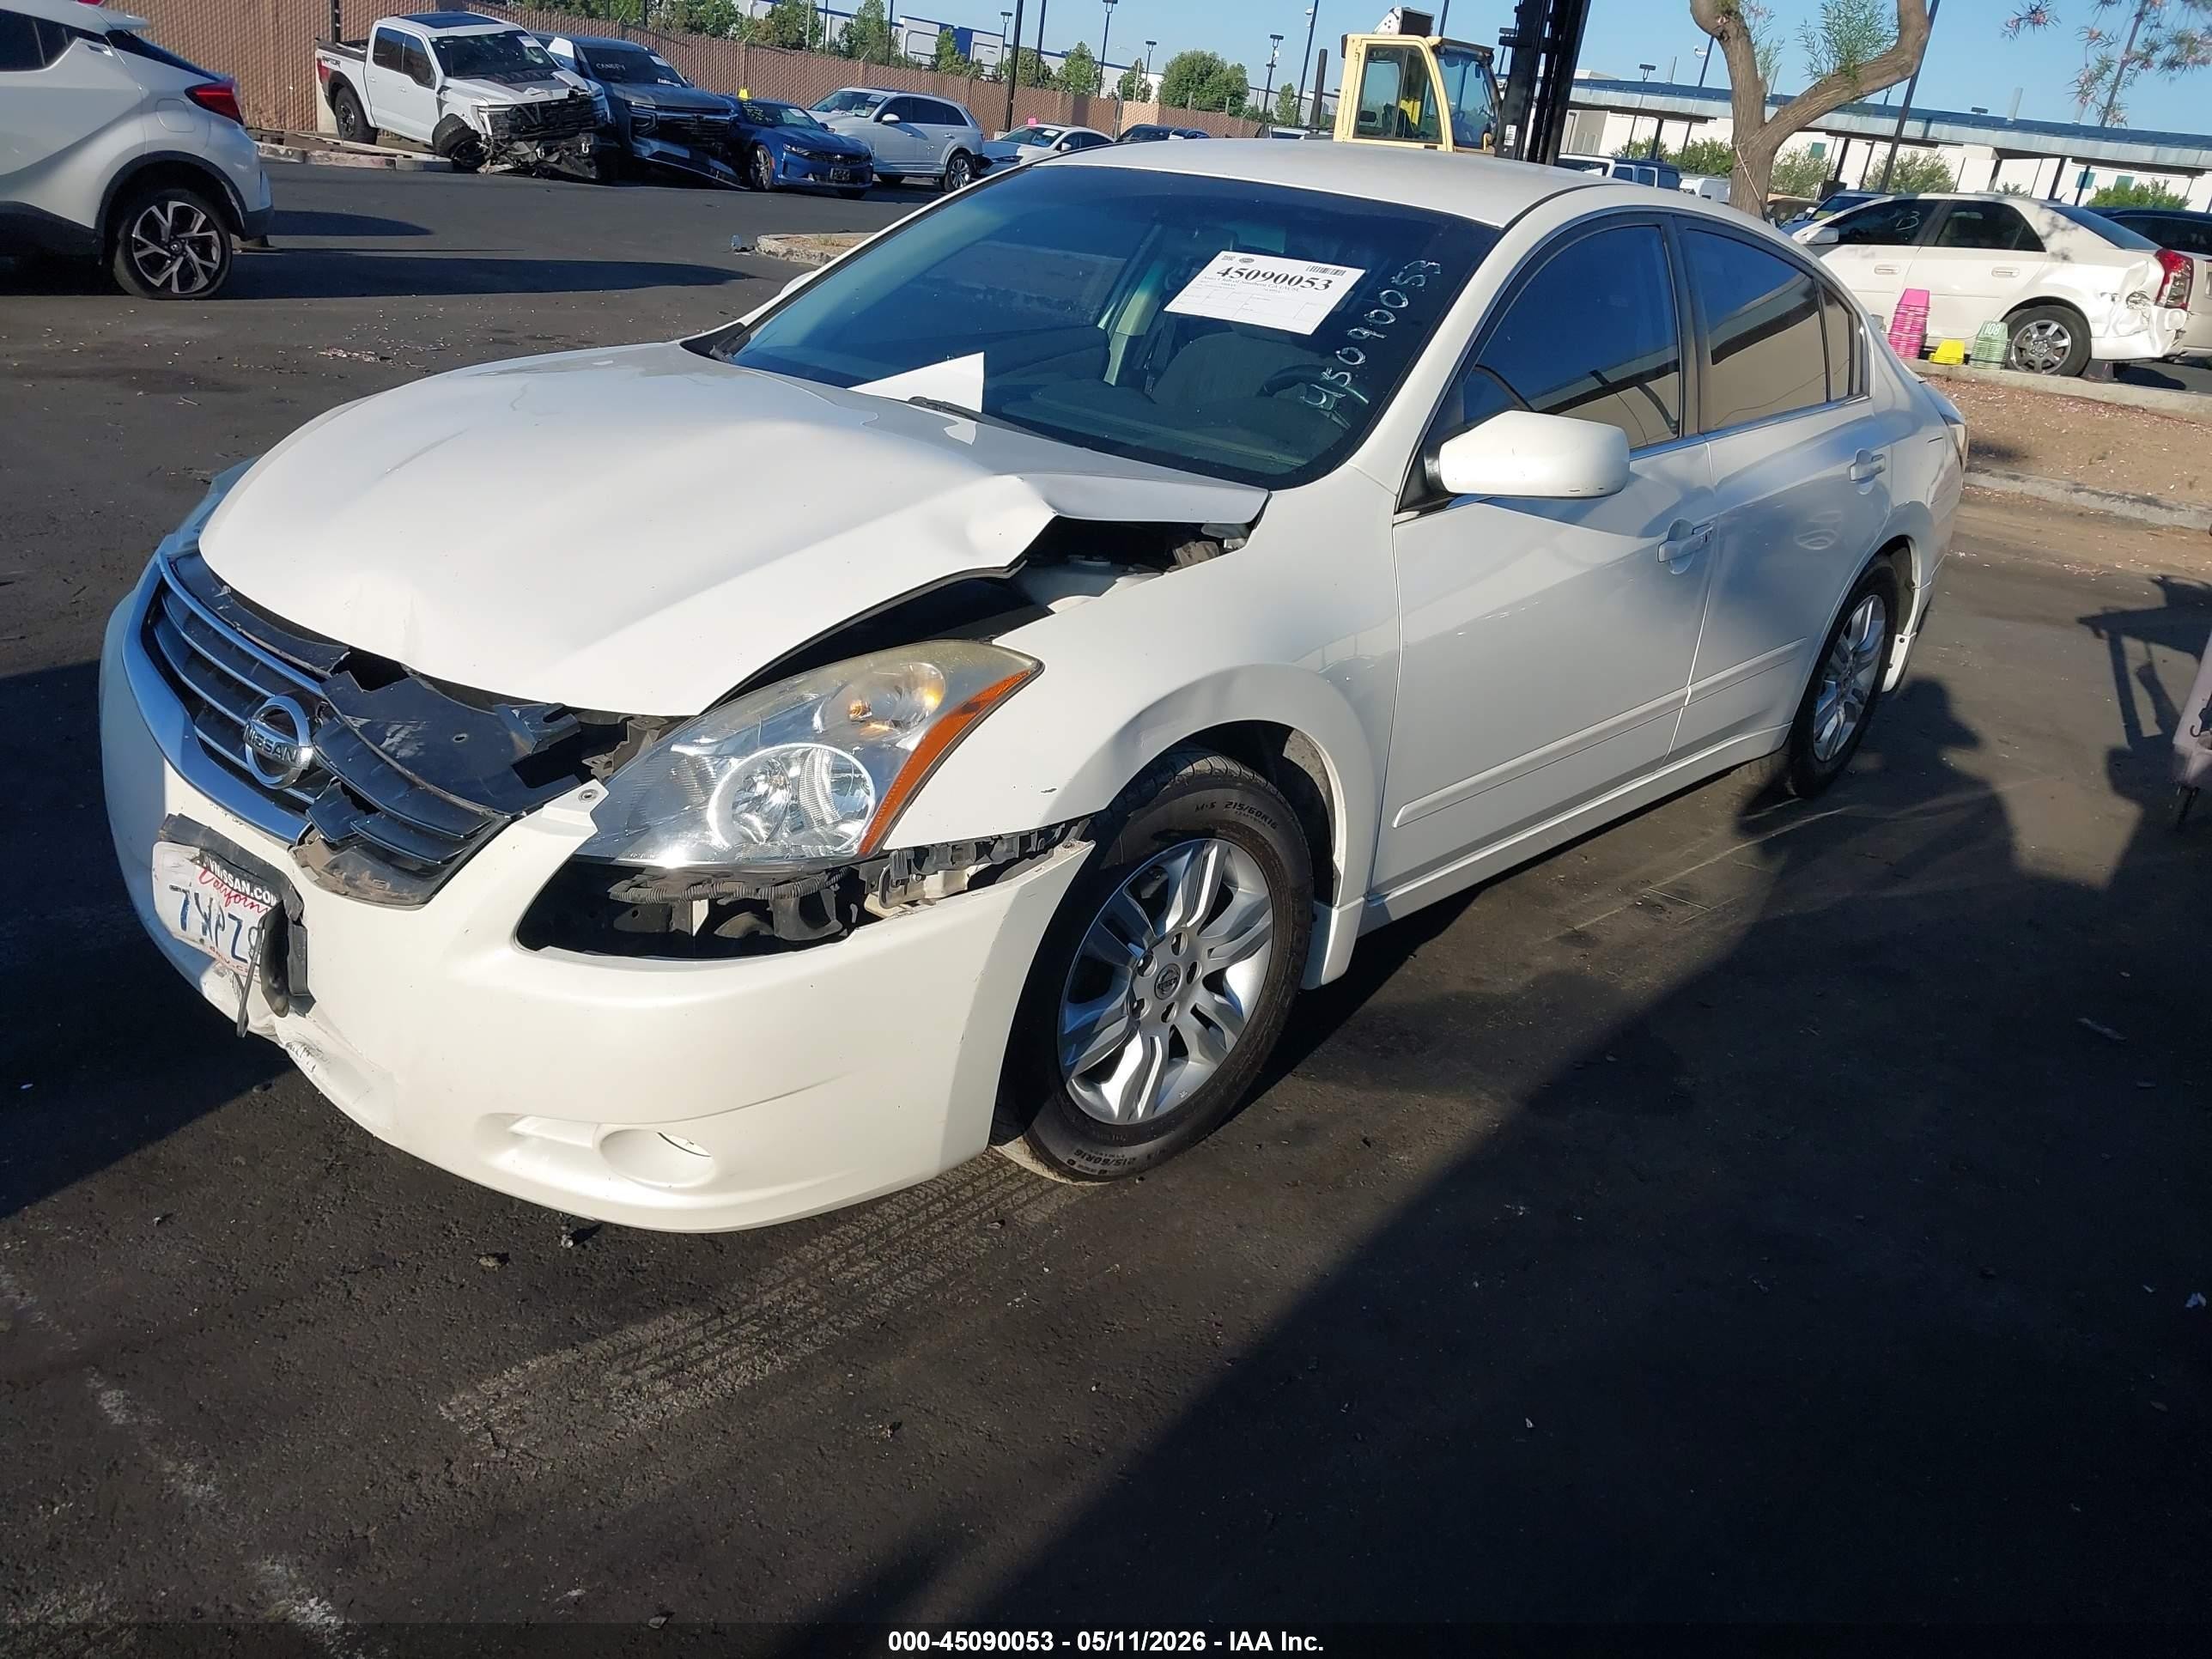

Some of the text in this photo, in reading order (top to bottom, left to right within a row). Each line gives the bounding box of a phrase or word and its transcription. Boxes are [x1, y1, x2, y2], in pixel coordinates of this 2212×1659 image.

[1216, 266, 1334, 292] 45090053
[1299, 260, 1442, 406] 45090053
[1984, 322, 2002, 335] 108
[243, 724, 298, 763] NISSAN
[1224, 799, 1279, 830] 215/60R16
